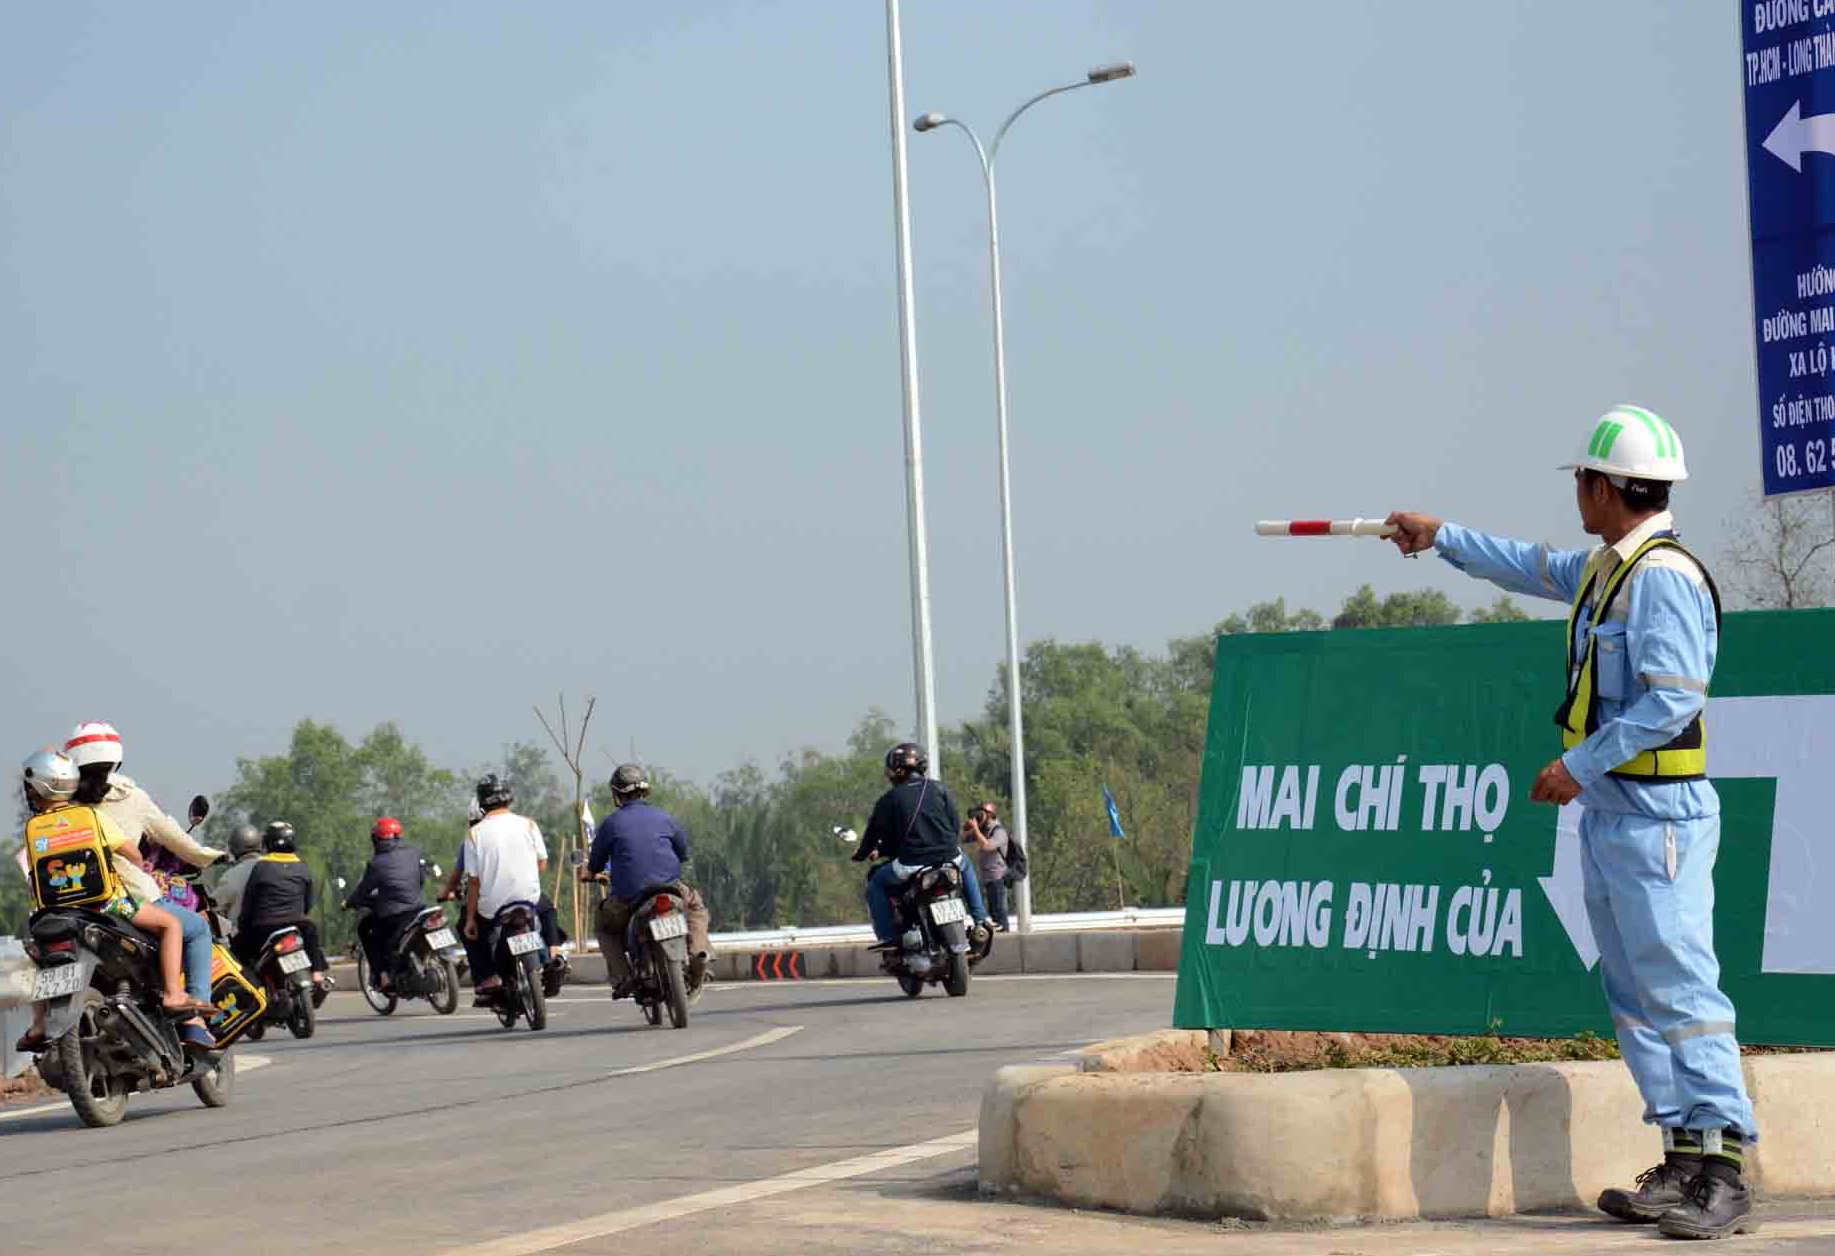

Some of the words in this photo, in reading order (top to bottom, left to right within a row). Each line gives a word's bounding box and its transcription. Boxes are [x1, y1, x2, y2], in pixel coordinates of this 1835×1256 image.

[1746, 46, 1781, 87] TP.HCM
[1788, 38, 1812, 76] LONG
[1763, 308, 1807, 342] ĐƯỜNG
[1810, 305, 1834, 334] MAI
[1788, 351, 1807, 378] XA
[1810, 340, 1827, 378] LỘ
[1773, 392, 1786, 428] SỐ
[1788, 393, 1813, 430] ĐIỆN
[1806, 438, 1827, 474] 62
[1236, 764, 1320, 830] MAI
[1334, 754, 1407, 831] CHÍ
[1419, 763, 1510, 843] THỌ
[1343, 882, 1440, 960] ĐỊNH
[1446, 868, 1523, 958] CỦA
